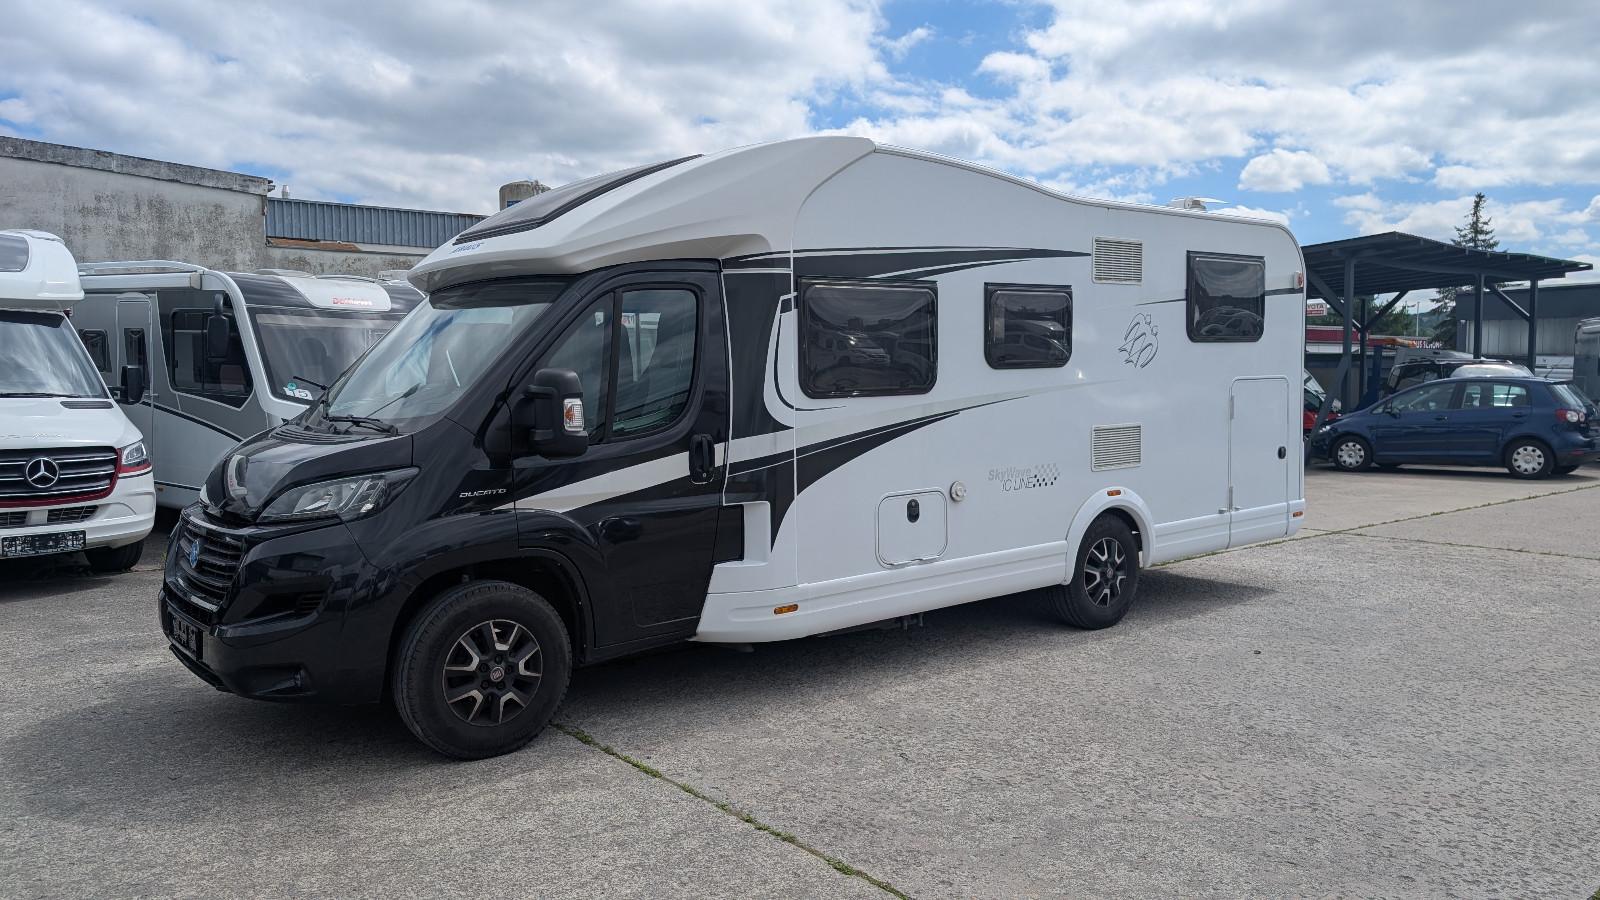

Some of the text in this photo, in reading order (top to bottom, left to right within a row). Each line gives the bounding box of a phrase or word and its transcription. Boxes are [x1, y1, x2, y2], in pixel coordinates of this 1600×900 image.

[987, 466, 1032, 481] SkyWave
[1013, 476, 1034, 491] LINE
[459, 488, 507, 498] DUCATO
